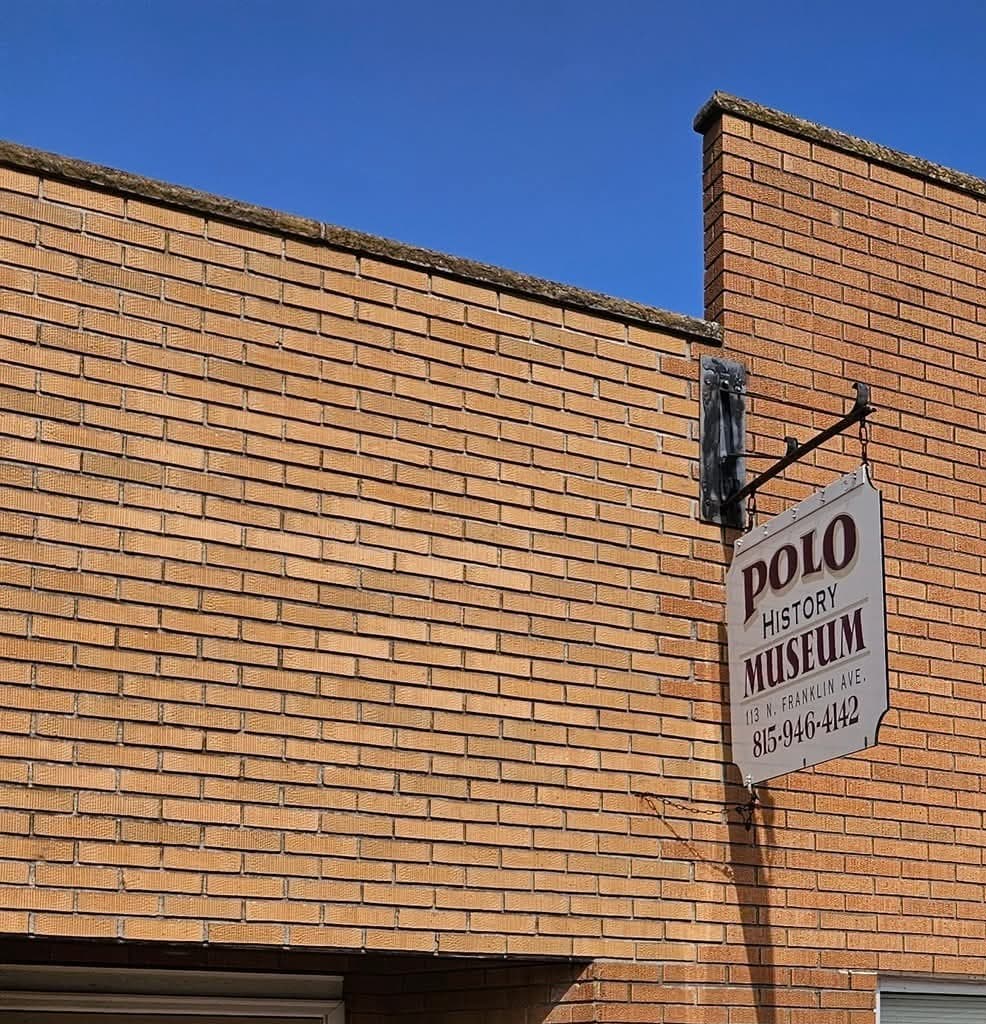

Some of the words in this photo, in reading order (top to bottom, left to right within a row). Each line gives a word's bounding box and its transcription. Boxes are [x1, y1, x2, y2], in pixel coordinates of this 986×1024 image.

[741, 513, 858, 625] POLO
[762, 583, 839, 639] HISTORY
[743, 607, 867, 698] MUSEUM
[745, 707, 760, 726] 113
[766, 702, 777, 719] N.
[782, 678, 835, 713] FRANKLIN
